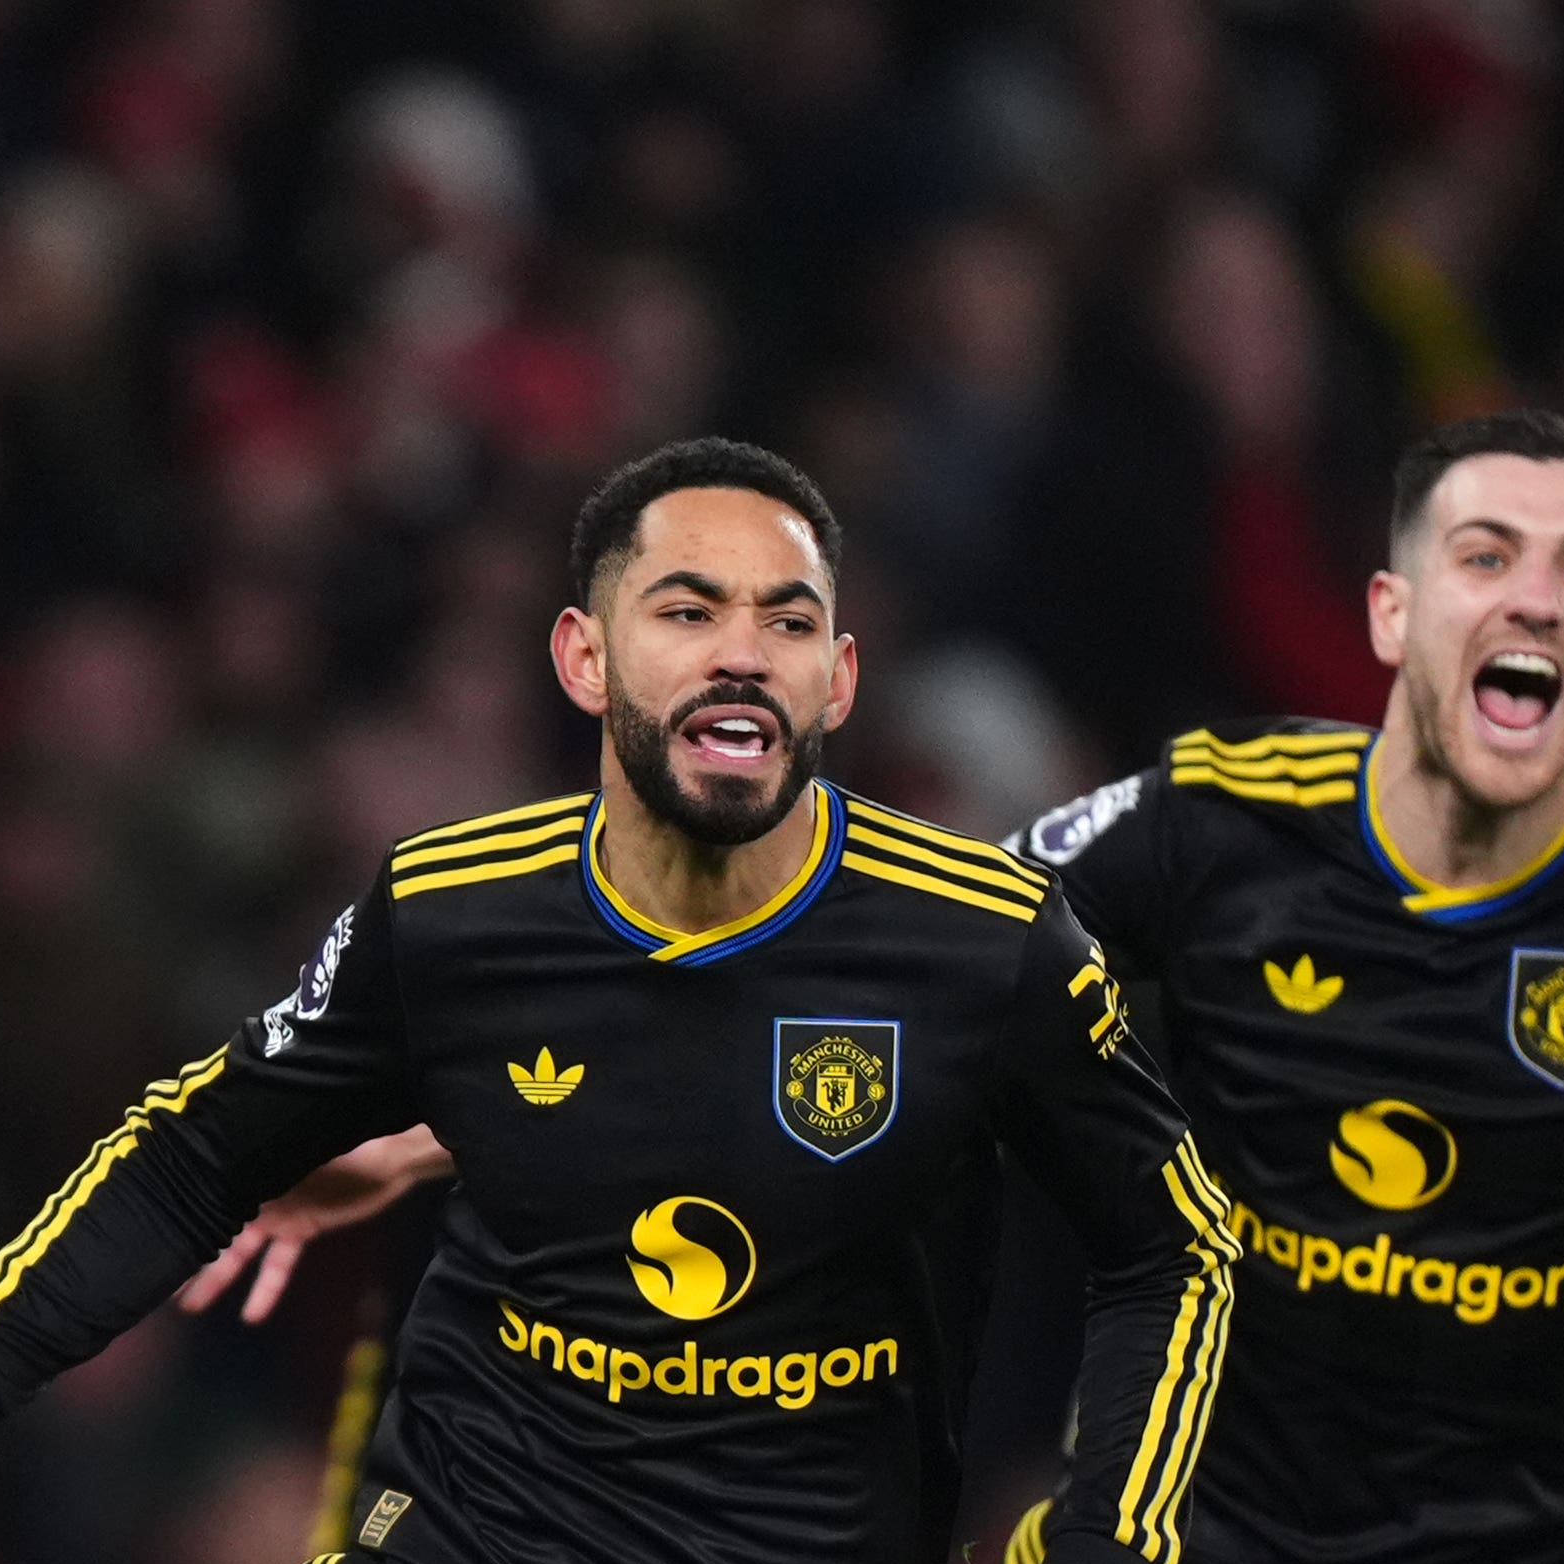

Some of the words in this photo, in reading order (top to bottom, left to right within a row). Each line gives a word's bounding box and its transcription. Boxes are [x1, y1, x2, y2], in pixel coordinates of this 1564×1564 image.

[797, 1043, 876, 1077] MANCHESTER
[808, 1111, 864, 1130] UNITED
[497, 1300, 899, 1410] Snapdragon
